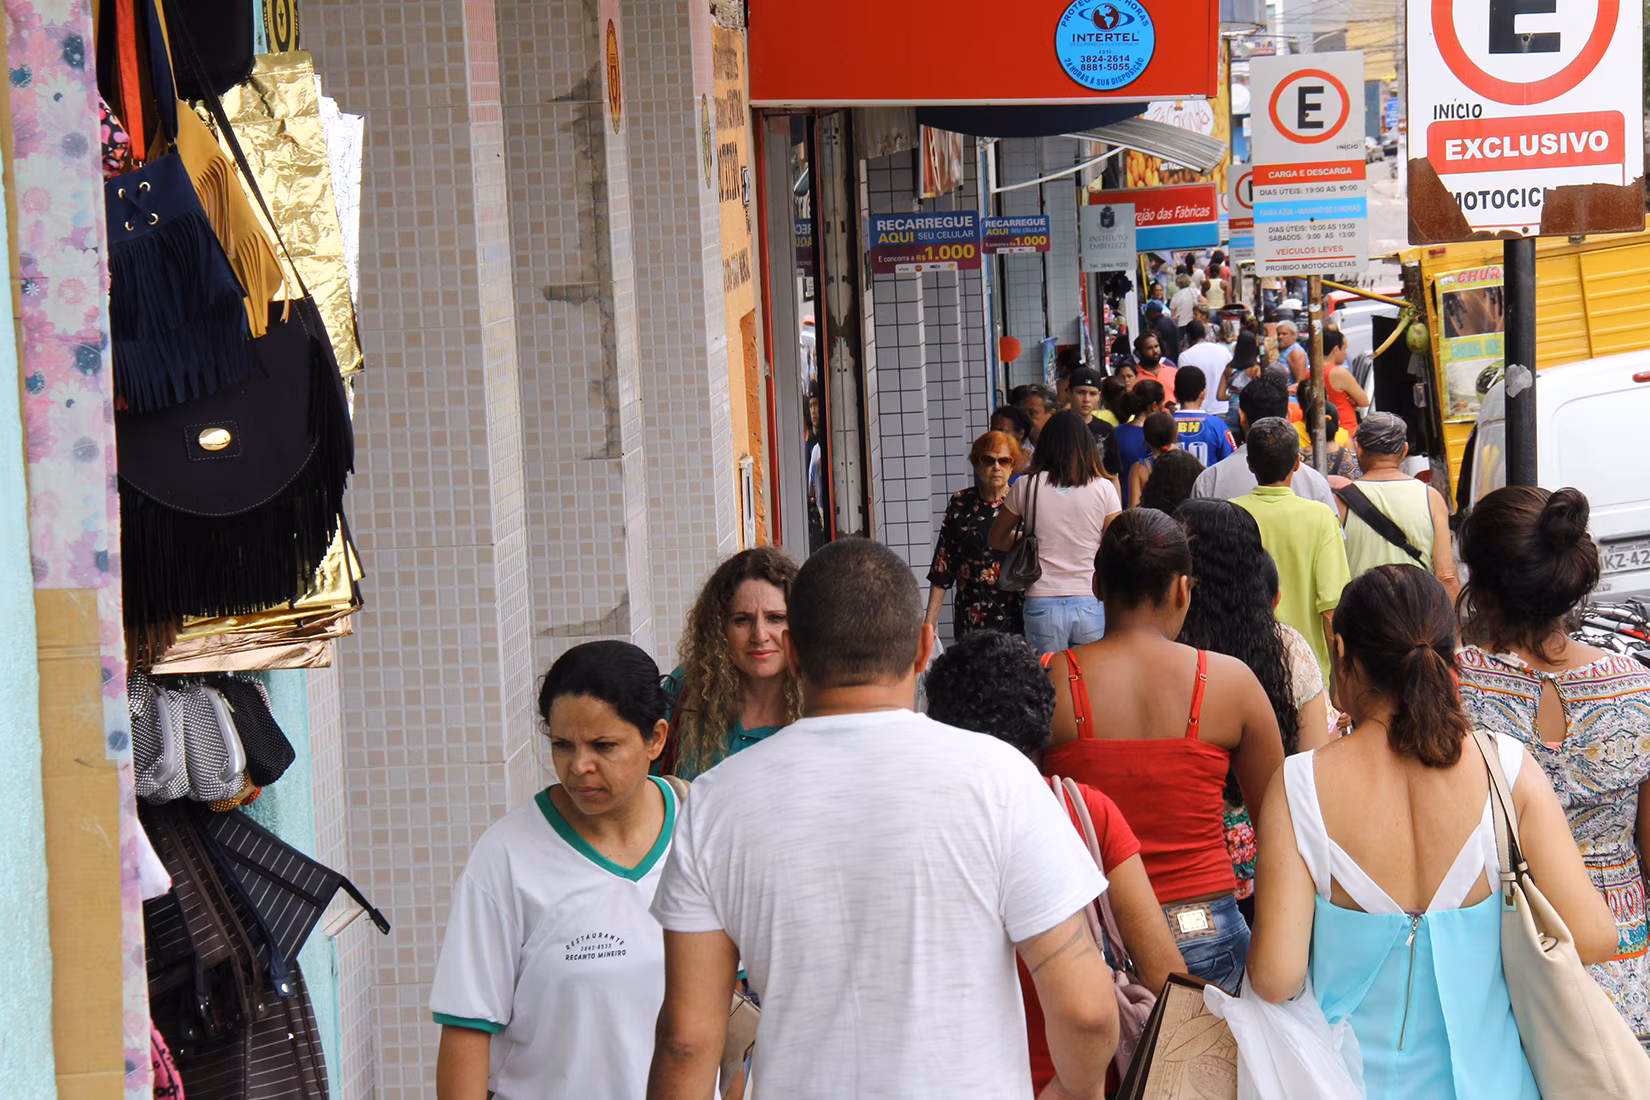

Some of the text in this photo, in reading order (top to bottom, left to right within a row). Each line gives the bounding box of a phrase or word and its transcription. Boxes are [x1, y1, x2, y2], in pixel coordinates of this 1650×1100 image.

[1072, 33, 1139, 42] INTERTEL
[1070, 65, 1089, 82] HORAS
[1096, 78, 1110, 86] SUA
[1298, 86, 1324, 129] E
[1432, 98, 1483, 120] INÍCIO
[1445, 130, 1609, 161] EXCLUSIVO
[1268, 169, 1298, 179] CARGA
[1306, 167, 1352, 176] DESCARGA
[1135, 204, 1210, 225] rejão das Fábricas
[876, 216, 974, 231] RECARREGUE
[986, 218, 1046, 228] RECARREGUE
[878, 230, 974, 244] AQUI SEU CELULAR
[1276, 246, 1316, 255] VEÍCULOS
[1302, 261, 1356, 270] MOTOCICLETAS
[1458, 267, 1504, 284] CHUR
[1178, 422, 1200, 432] BH
[566, 932, 624, 950] RESTAURANTE
[565, 950, 626, 961] RECANTO MINEIRO
